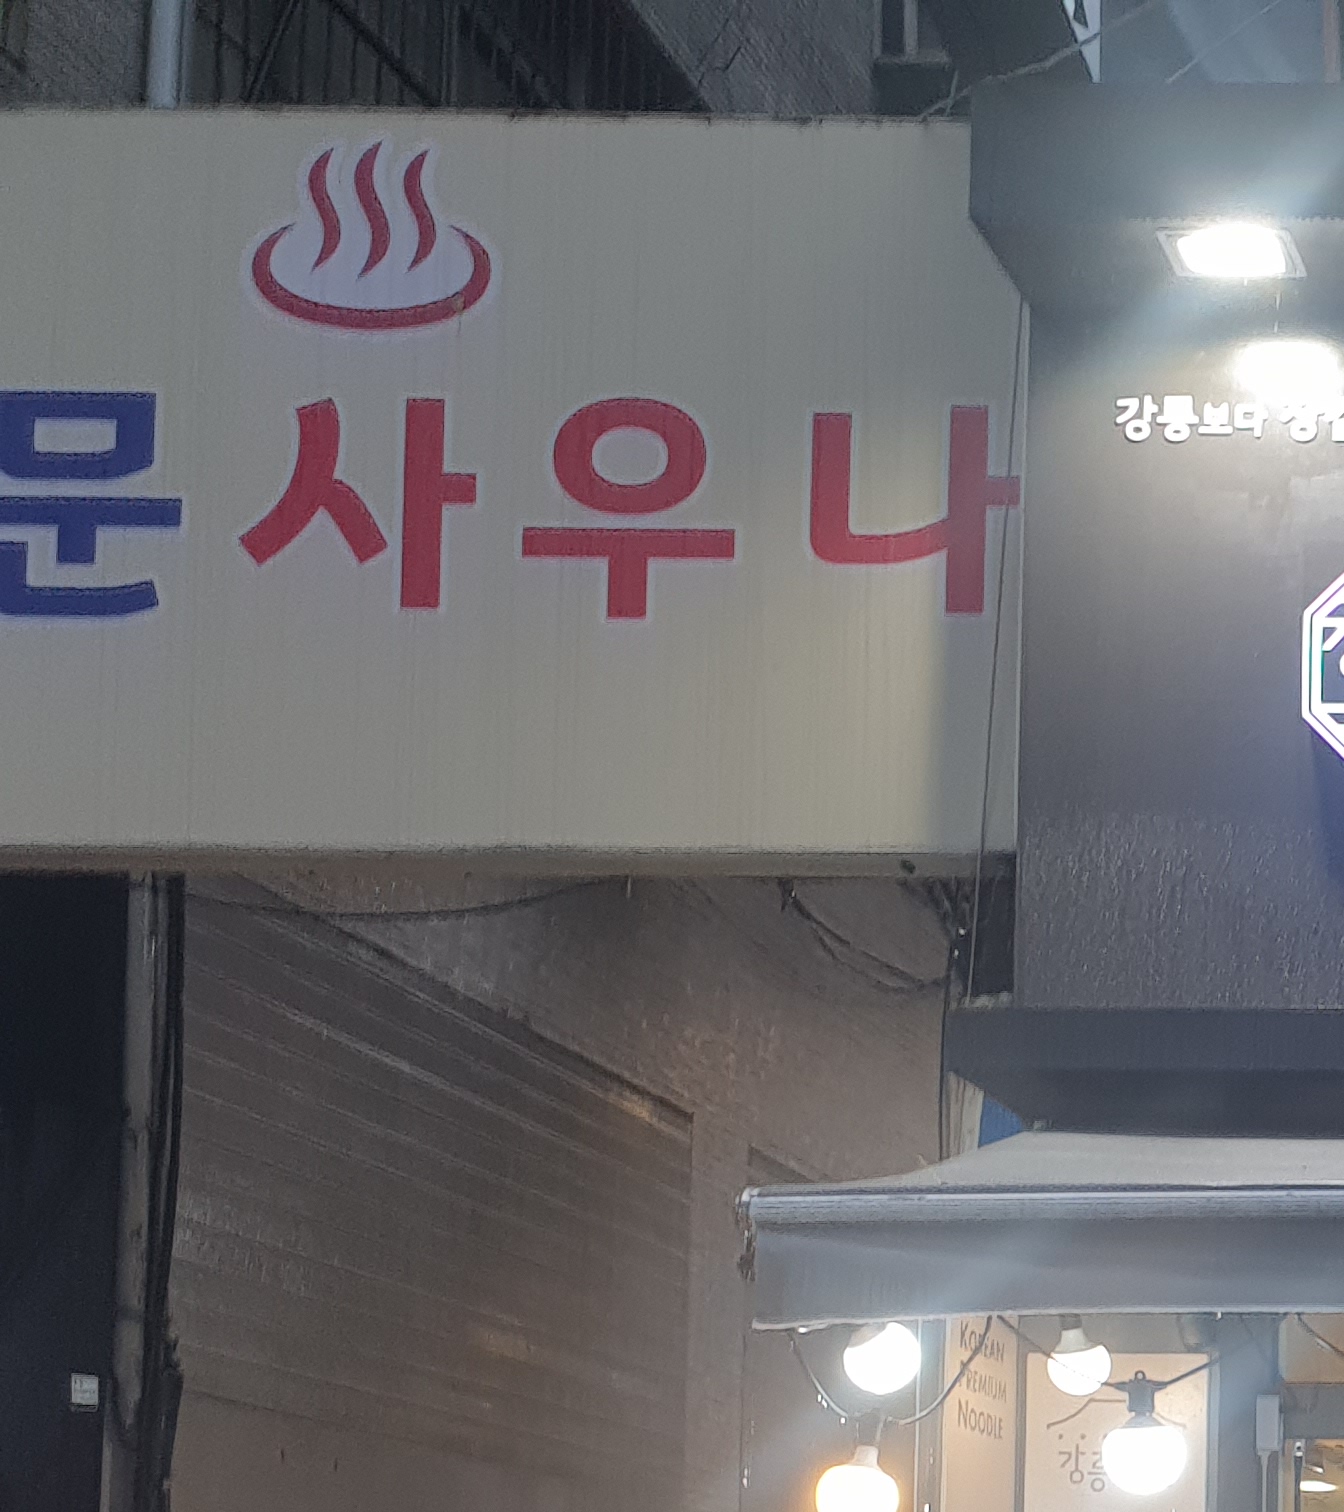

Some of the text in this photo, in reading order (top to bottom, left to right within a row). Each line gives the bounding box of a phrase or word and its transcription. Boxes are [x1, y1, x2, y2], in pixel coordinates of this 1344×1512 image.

[1114, 394, 1268, 442] 강릉보다
[238, 397, 1021, 619] 사우나
[957, 1398, 1003, 1440] NOODLE
